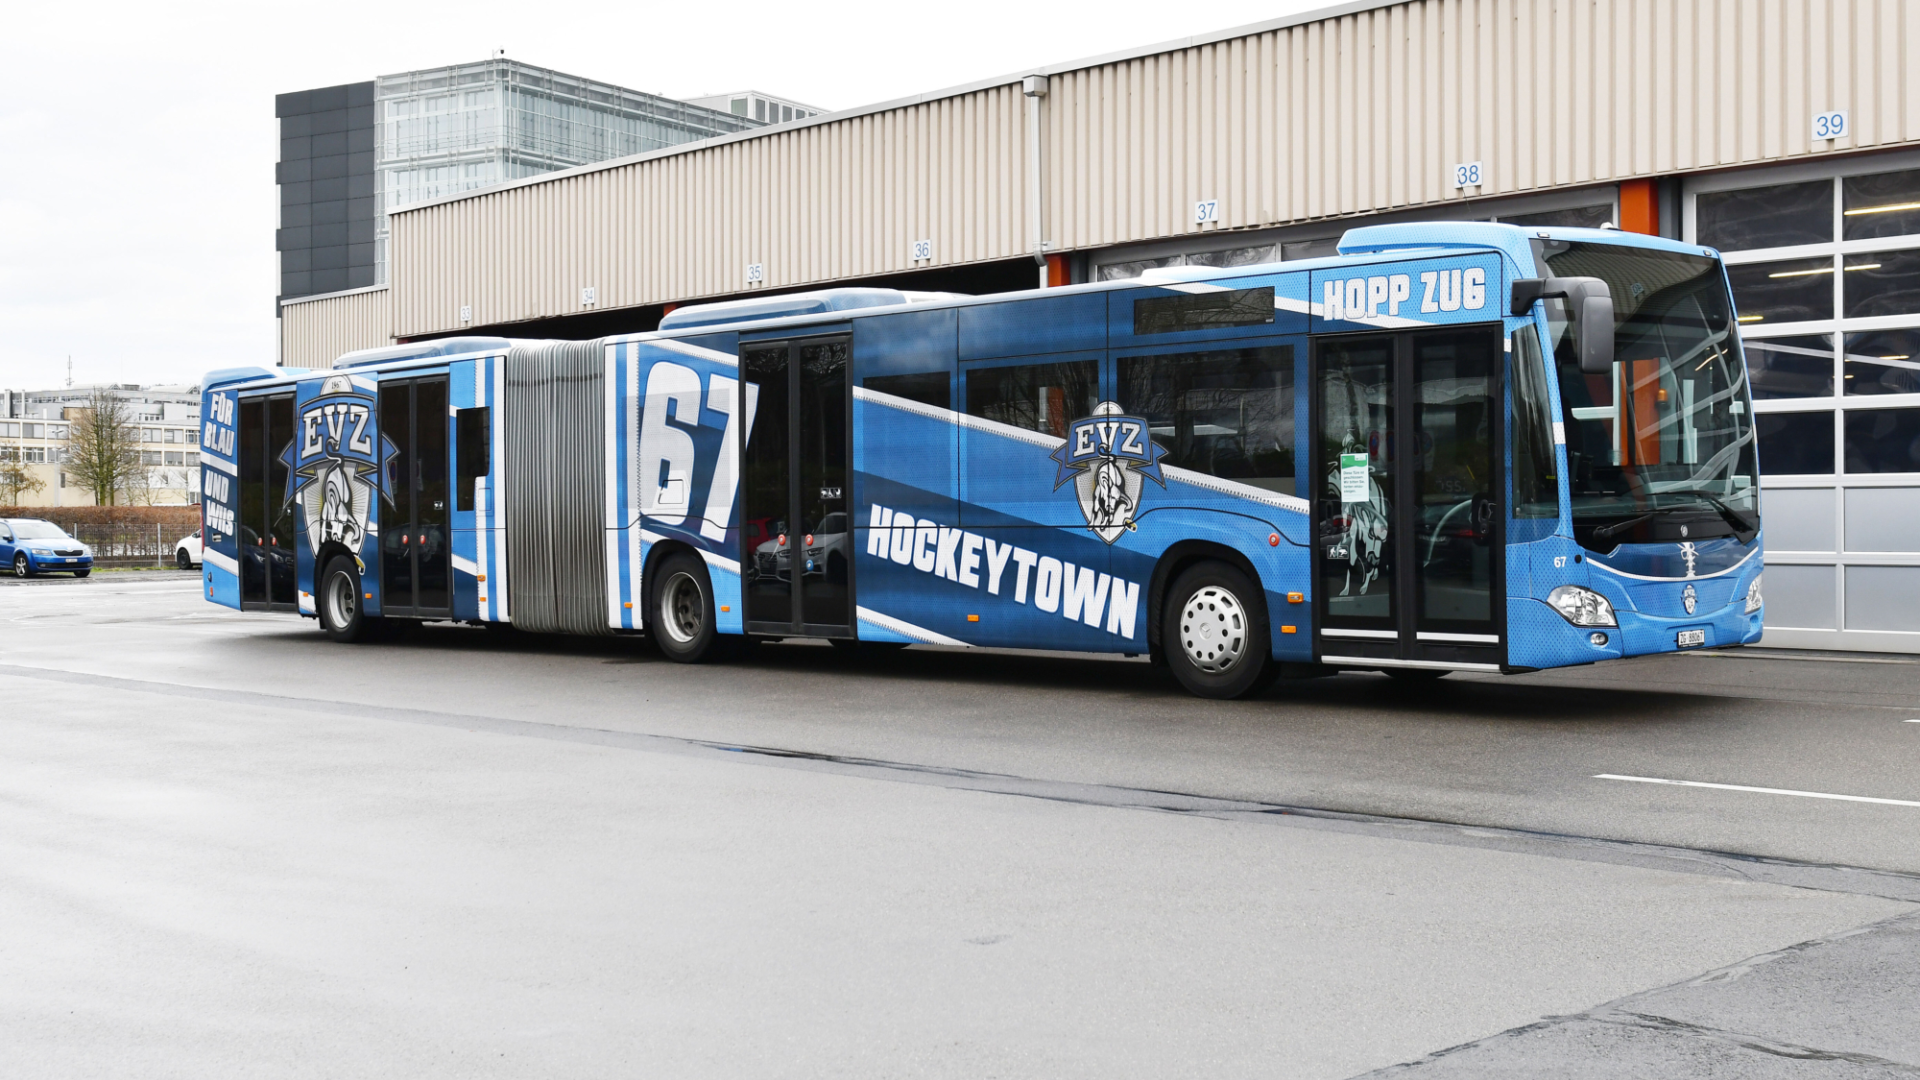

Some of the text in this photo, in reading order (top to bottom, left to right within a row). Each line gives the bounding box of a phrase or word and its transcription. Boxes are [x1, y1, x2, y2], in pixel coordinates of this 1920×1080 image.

[1817, 114, 1844, 137] 39
[1458, 164, 1479, 185] 38
[1198, 202, 1216, 221] 37
[915, 242, 929, 258] 36
[748, 265, 761, 280] 35
[583, 289, 593, 302] 34
[1323, 267, 1486, 321] HOPP ZUG
[461, 307, 470, 319] 33
[203, 421, 235, 457] BLAU
[301, 403, 373, 459] EVZ
[1073, 422, 1143, 457] EVZ
[638, 361, 760, 543] 67
[204, 469, 229, 504] UND
[867, 502, 1140, 640] HOCKEYTOWN
[1553, 556, 1566, 568] 67
